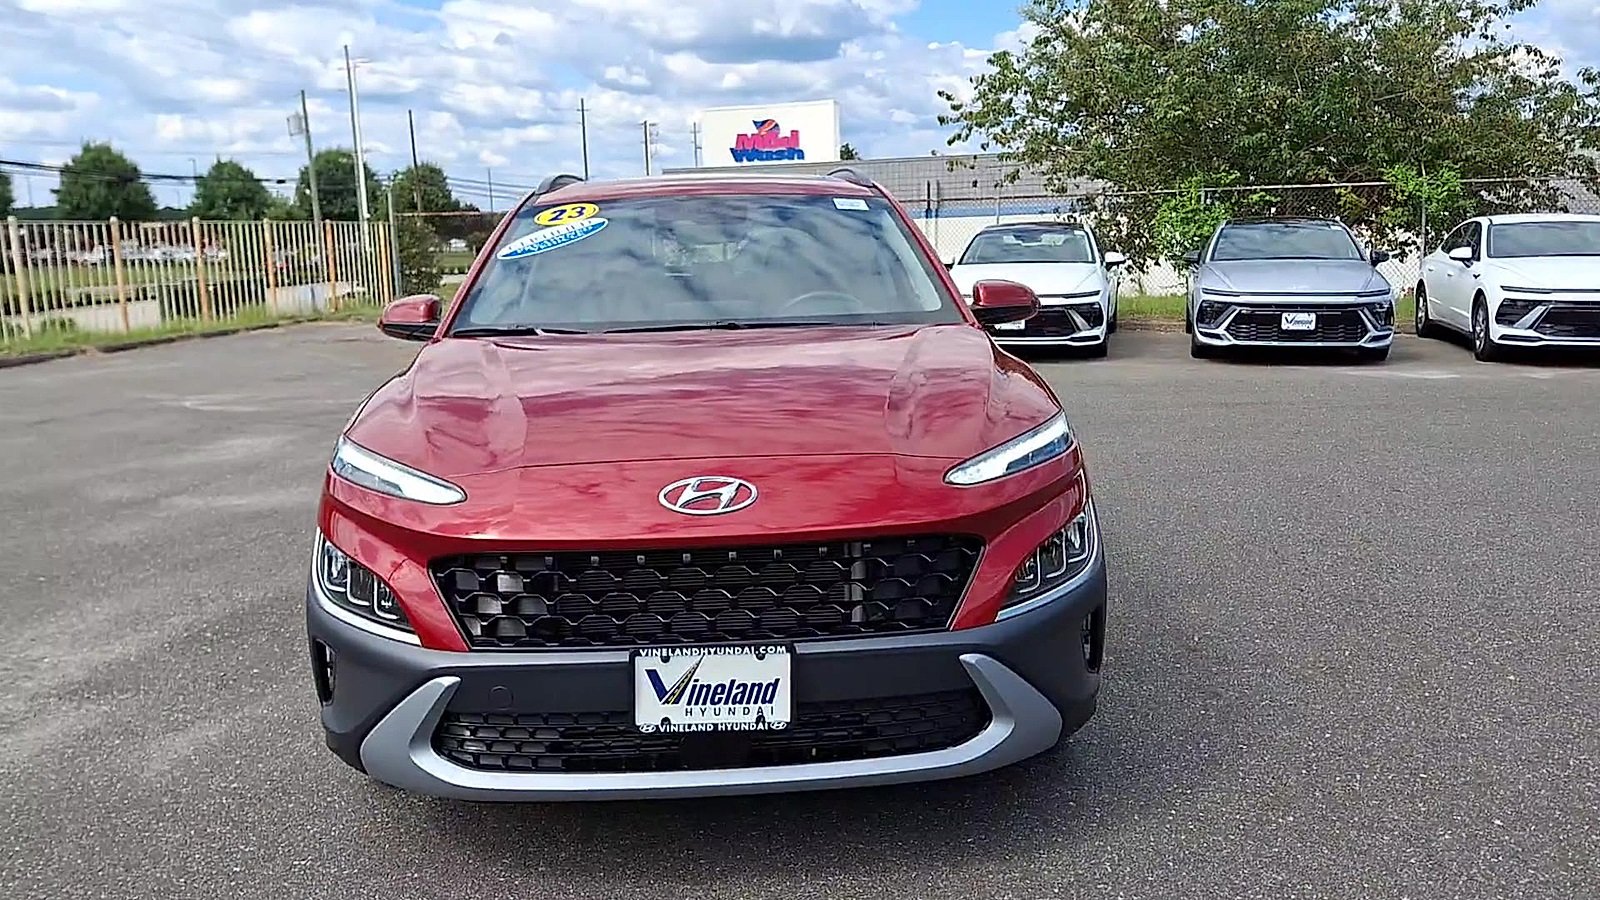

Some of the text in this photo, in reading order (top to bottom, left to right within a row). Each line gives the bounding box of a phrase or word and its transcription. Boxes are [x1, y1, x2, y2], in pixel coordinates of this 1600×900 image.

[730, 147, 805, 163] Wash
[548, 206, 587, 222] 23
[639, 645, 787, 657] VINELANDHYUNDAI.COM
[645, 655, 781, 706] Vineland
[685, 705, 775, 717] HYUNDAI
[659, 722, 769, 733] VINELAND HYUNDAI
